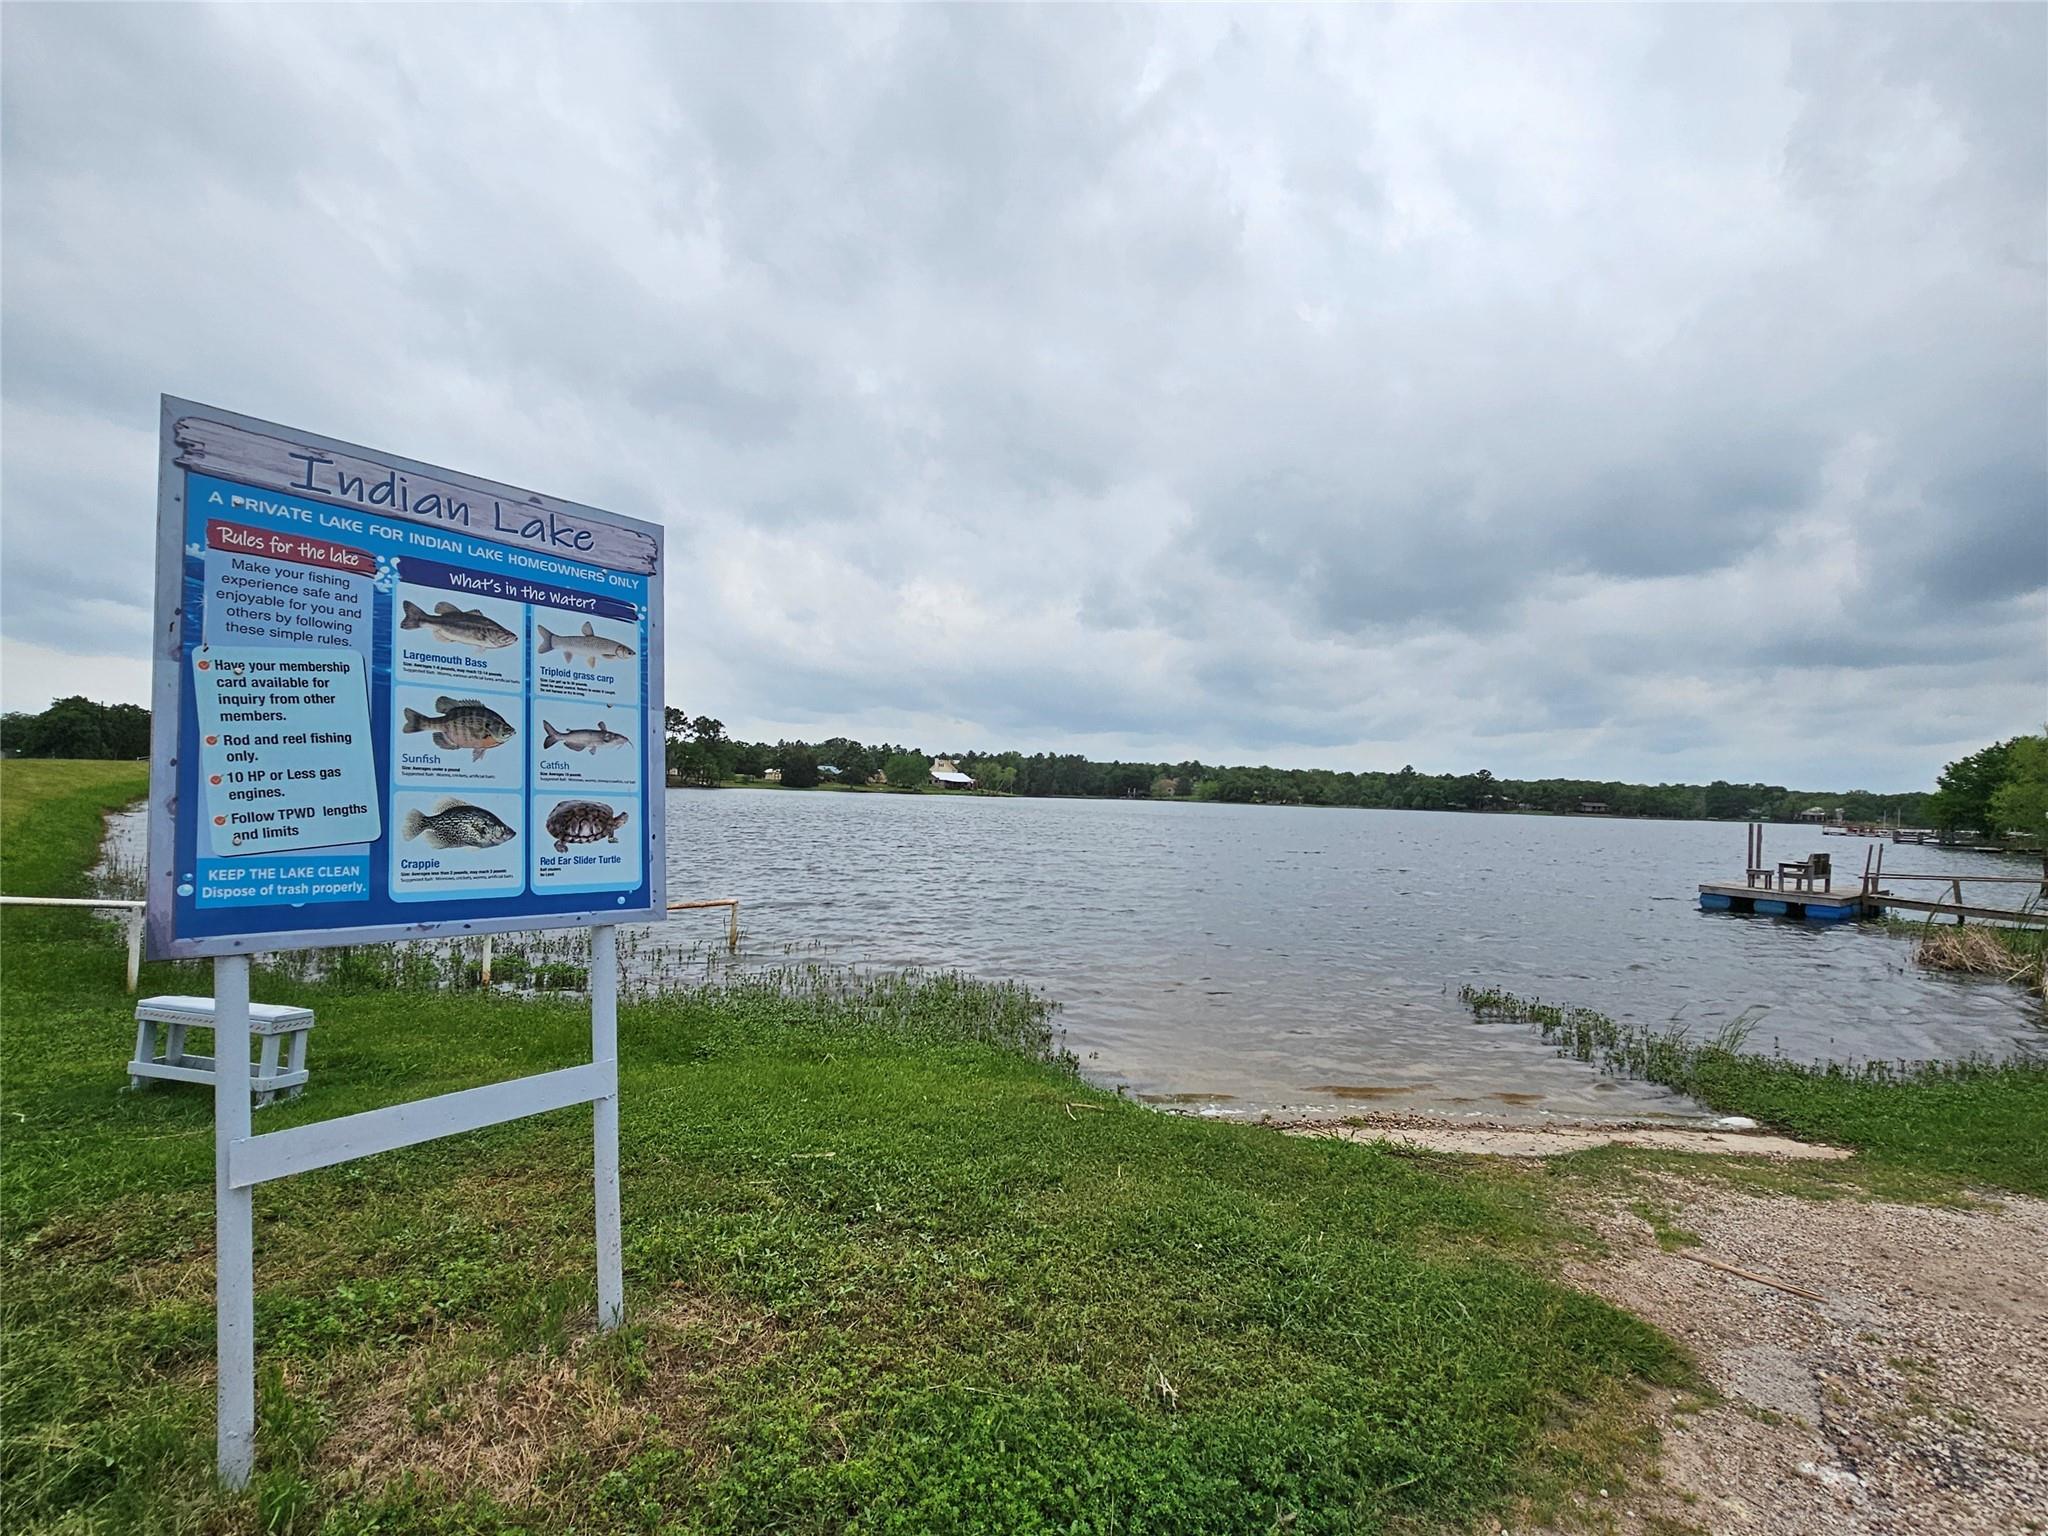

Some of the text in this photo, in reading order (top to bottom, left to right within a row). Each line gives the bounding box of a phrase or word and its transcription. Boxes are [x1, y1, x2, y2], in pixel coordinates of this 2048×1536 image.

[288, 452, 594, 552] Indian Lake
[208, 491, 639, 590] A PRIVATE LAKE FOR INDIAN LAKE HOMEOWNERS ONLY
[217, 527, 359, 566] Rules for the lake
[232, 559, 350, 589] Make your fishing
[222, 576, 358, 604] experience safe and
[450, 573, 596, 610] What's in the Water?
[216, 590, 361, 619] enjoyable for you and
[227, 607, 352, 634] others by following
[226, 621, 352, 647] these simple rules.
[403, 649, 487, 668] Largemouth Bass
[215, 660, 350, 674] Have your membership
[217, 677, 330, 688] card available for
[540, 666, 571, 677] Triploid
[573, 672, 595, 681] grass
[597, 675, 614, 684] carp
[218, 694, 335, 706] inquiry from other
[220, 711, 286, 721] members.
[224, 733, 352, 745] Rod and reel fishing
[227, 752, 258, 763] only.
[402, 754, 440, 764] Sunfish
[540, 761, 569, 769] Catfish
[227, 768, 341, 783] 10 HP or Less gas
[229, 788, 285, 801] engines.
[232, 804, 367, 824] Follow TPWD lengths
[233, 826, 299, 841] and limits
[401, 859, 440, 870] Crappie
[540, 857, 555, 865] Red
[574, 856, 596, 864] Slider
[599, 855, 621, 863] Turtle
[209, 866, 359, 880] KEEP THE LAKE CLEAN
[202, 882, 366, 899] Dispose of trash properly.
